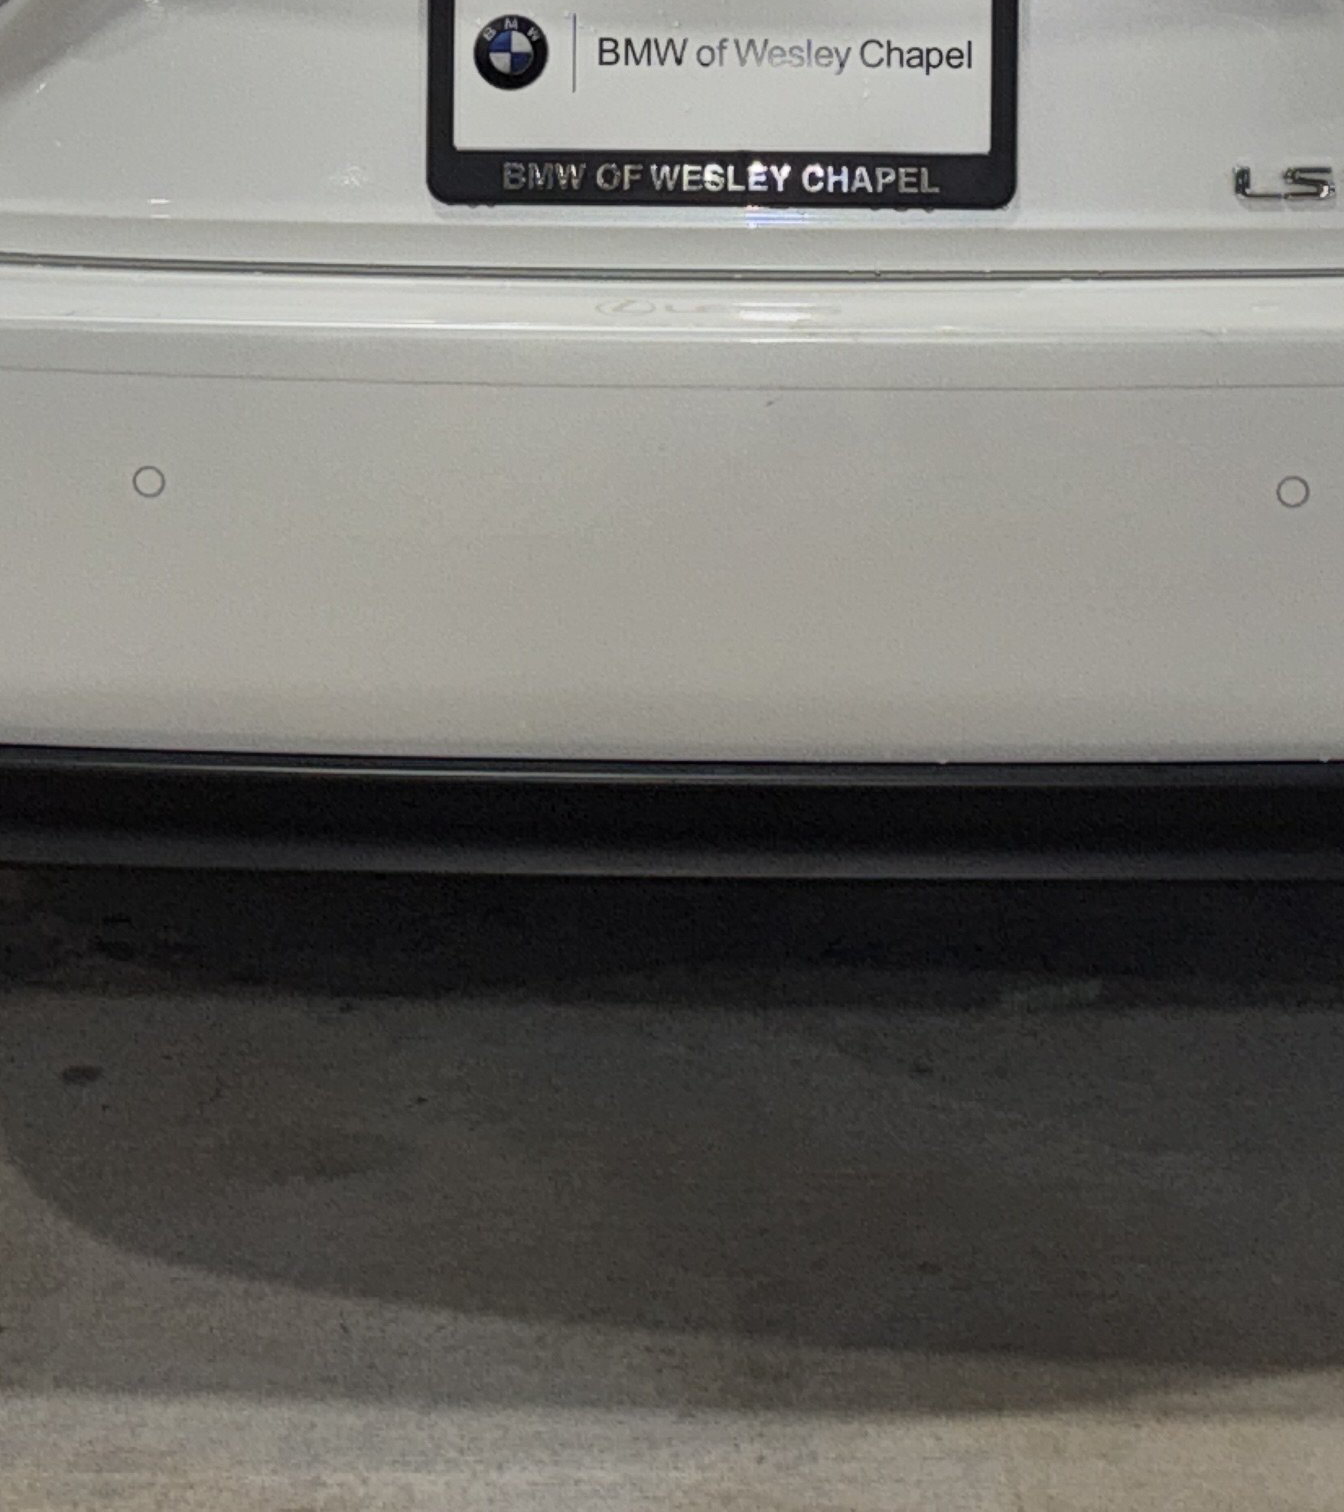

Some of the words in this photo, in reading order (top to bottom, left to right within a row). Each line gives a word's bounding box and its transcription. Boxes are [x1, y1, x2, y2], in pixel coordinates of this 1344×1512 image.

[482, 17, 541, 42] BMW
[598, 37, 688, 67] BMW
[696, 37, 729, 68] of
[733, 38, 852, 76] Wesley
[859, 38, 973, 76] Chapel
[502, 162, 586, 190] BMW
[596, 162, 644, 191] OF
[650, 162, 792, 192] WESLEY
[801, 163, 940, 194] CHAPEL
[1232, 165, 1336, 199] LS
